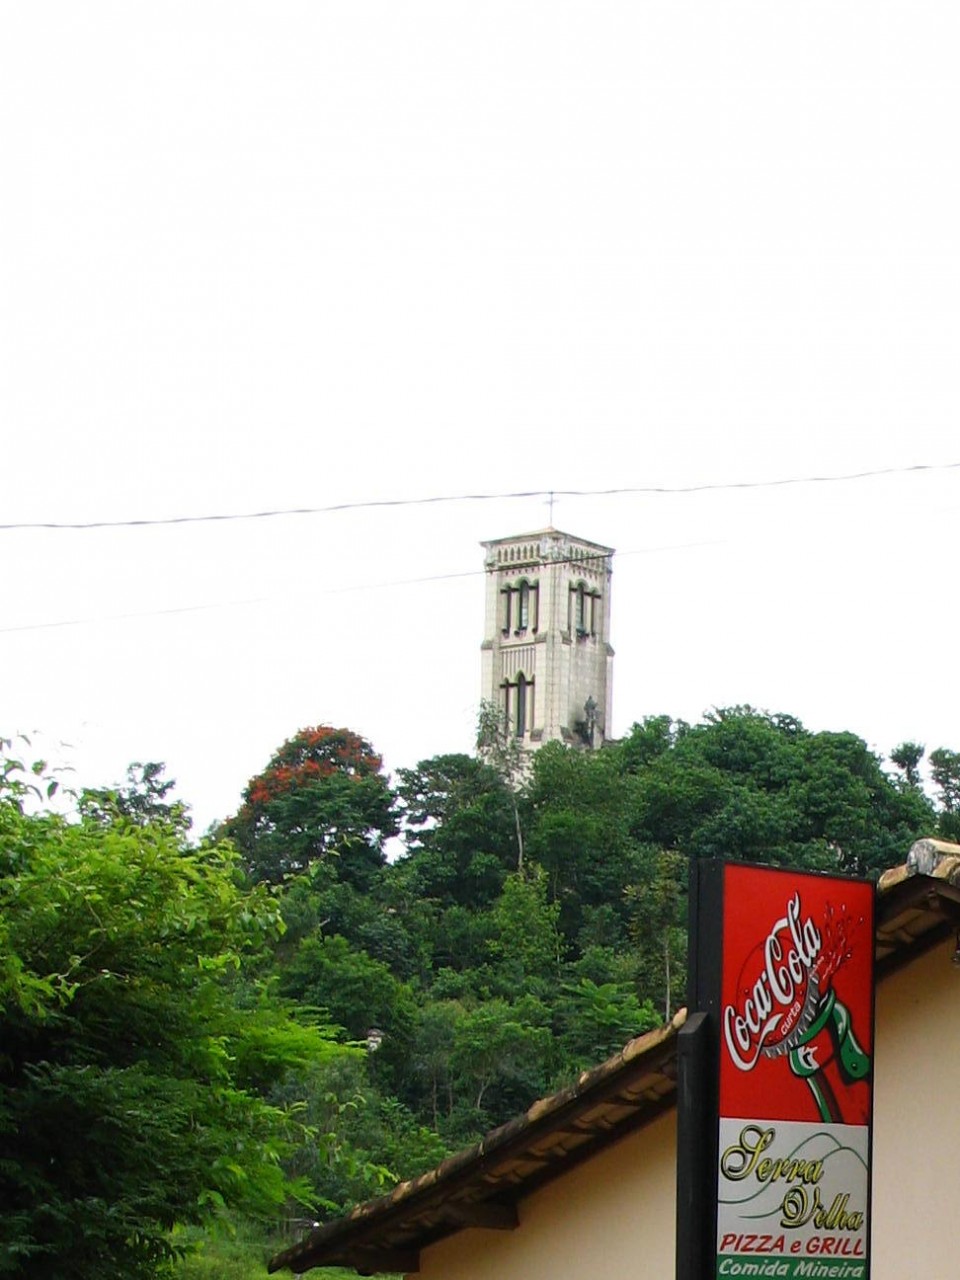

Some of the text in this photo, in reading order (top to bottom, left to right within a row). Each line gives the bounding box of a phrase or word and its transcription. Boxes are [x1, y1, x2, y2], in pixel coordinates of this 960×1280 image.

[780, 1001, 801, 1035] curta
[721, 1125, 824, 1184] Serra
[780, 1184, 864, 1231] Velha
[719, 1233, 864, 1256] PIZZA e GRILL
[718, 1259, 865, 1279] Comida Mineira
